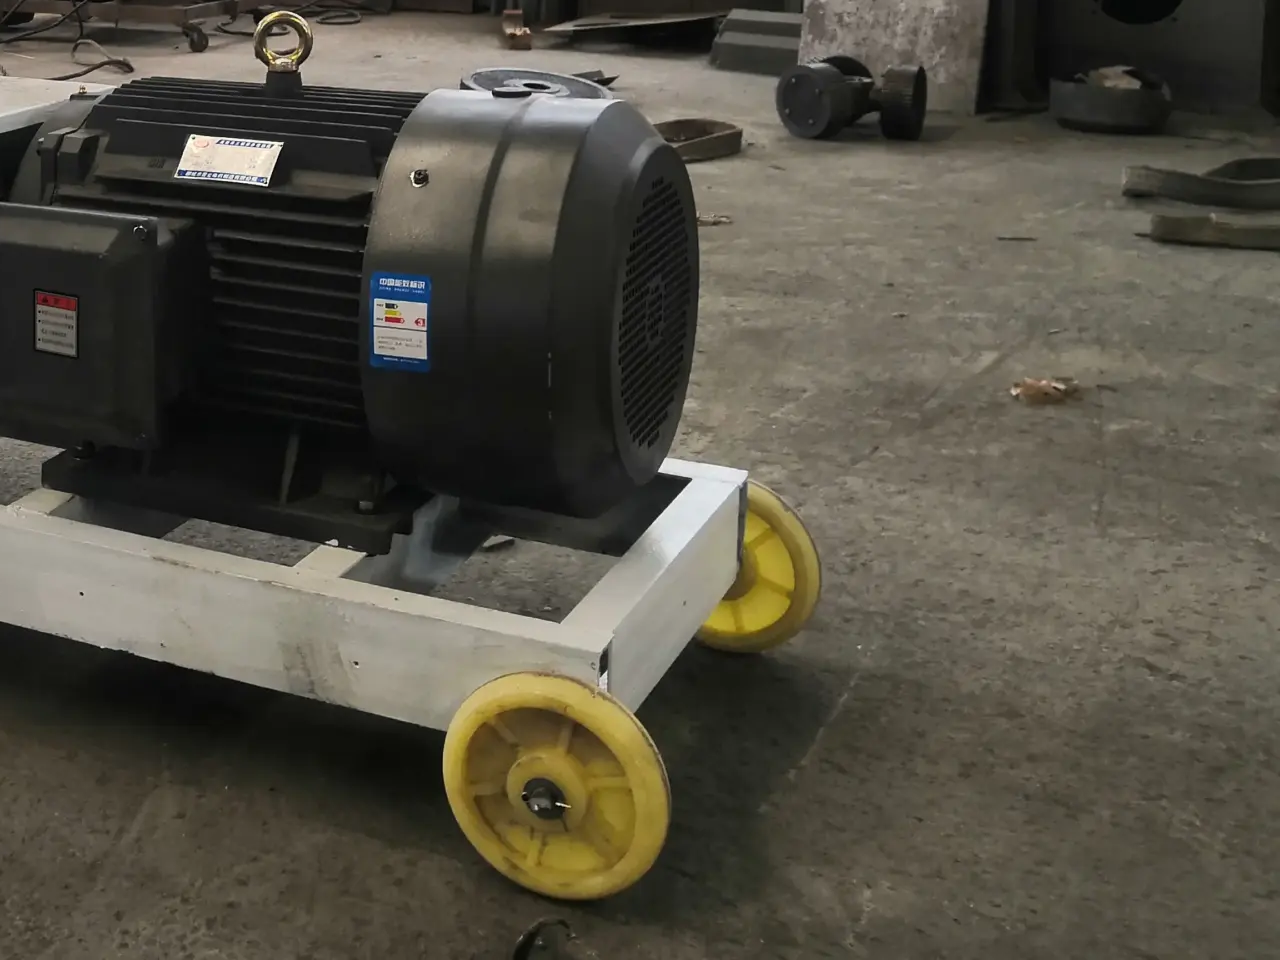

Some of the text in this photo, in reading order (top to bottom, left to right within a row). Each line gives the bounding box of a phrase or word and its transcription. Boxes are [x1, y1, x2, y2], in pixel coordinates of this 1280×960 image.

[379, 278, 426, 289] 中国能效标识
